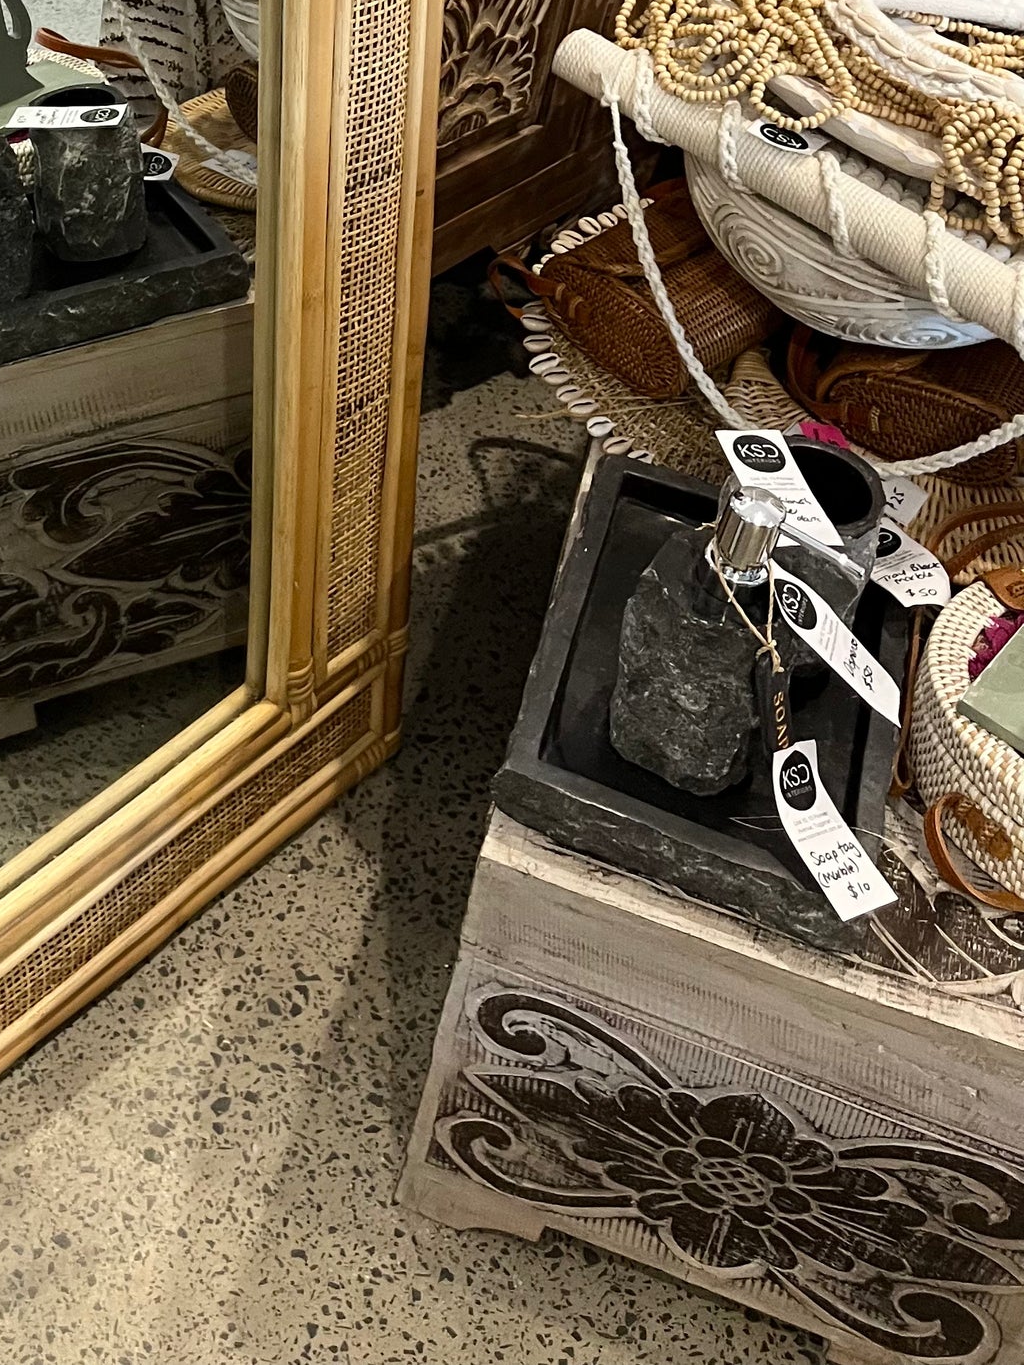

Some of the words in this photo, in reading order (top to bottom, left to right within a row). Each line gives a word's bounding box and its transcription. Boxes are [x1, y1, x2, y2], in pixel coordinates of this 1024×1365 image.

[809, 849, 839, 867] Soap
[836, 840, 862, 859] tag
[847, 881, 871, 900] $10
